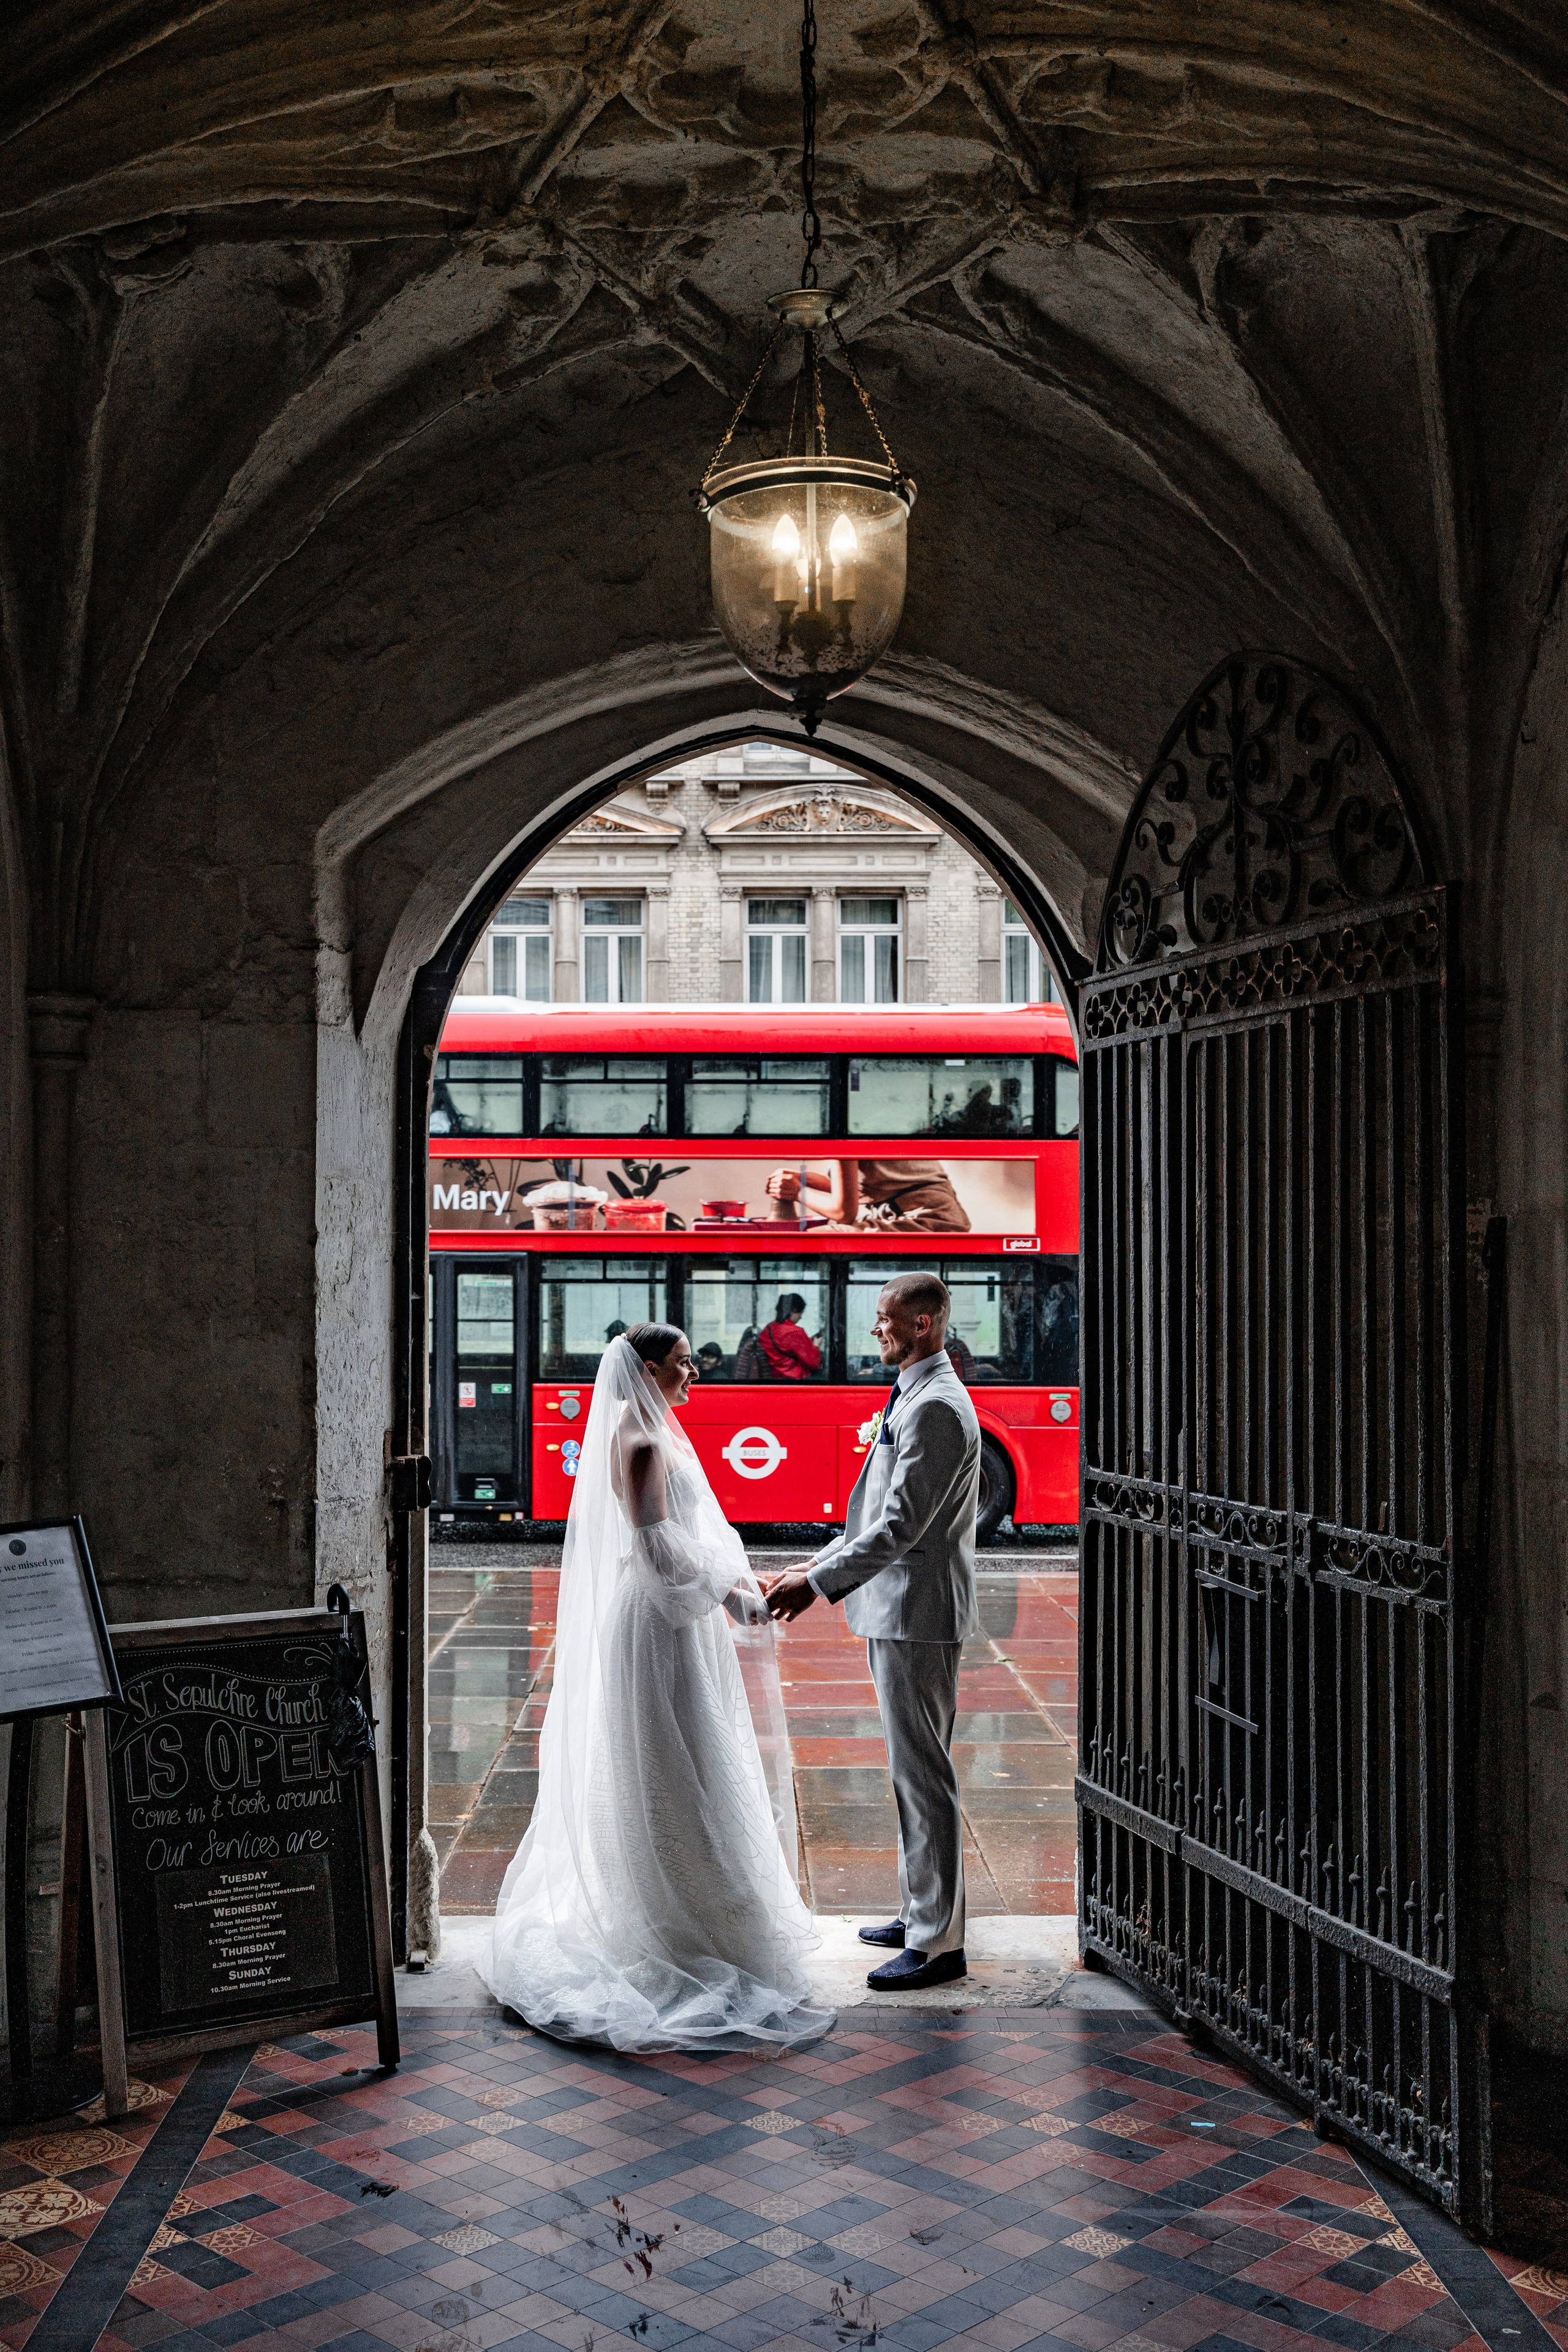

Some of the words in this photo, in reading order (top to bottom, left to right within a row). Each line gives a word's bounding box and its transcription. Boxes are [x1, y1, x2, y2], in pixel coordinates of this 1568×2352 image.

[433, 1184, 510, 1216] Mary
[1009, 1240, 1033, 1250] global
[18, 1558, 48, 1569] missed
[49, 1558, 64, 1567] you
[163, 1673, 258, 1717] Sepulchre
[265, 1683, 328, 1724] Church
[124, 1724, 189, 1803] IS
[187, 1804, 205, 1823] in
[276, 1781, 343, 1811] around!
[146, 1838, 192, 1871] Our
[220, 1871, 268, 1885] TUESDAY
[173, 1902, 193, 1910] 1-2pm
[195, 1897, 228, 1907] Lunchtime
[230, 1893, 254, 1902] Service
[255, 1890, 271, 1899] (also
[273, 1884, 315, 1896] livestreamed)
[208, 1888, 232, 1897] 8.30am
[233, 1885, 258, 1894] Morning
[260, 1881, 281, 1890] Prayer
[213, 1901, 277, 1918] WEDNESDAY
[209, 1920, 233, 1929] 8.30am
[235, 1917, 260, 1925] Morning
[262, 1913, 283, 1922] Prayer
[239, 1923, 270, 1932] Eucharist
[208, 1937, 232, 1945] 5.15pm
[233, 1933, 254, 1942] Choral
[256, 1929, 287, 1939] Evensong
[220, 1942, 276, 1958] THURSDAY
[213, 1960, 236, 1969] 8.30am
[238, 1956, 263, 1965] Morning
[265, 1953, 286, 1962] Prayer
[228, 1966, 272, 1981] SUNDAY
[210, 1984, 238, 1993] 10.30am
[239, 1980, 266, 1989] Morning
[267, 1976, 291, 1985] Service
